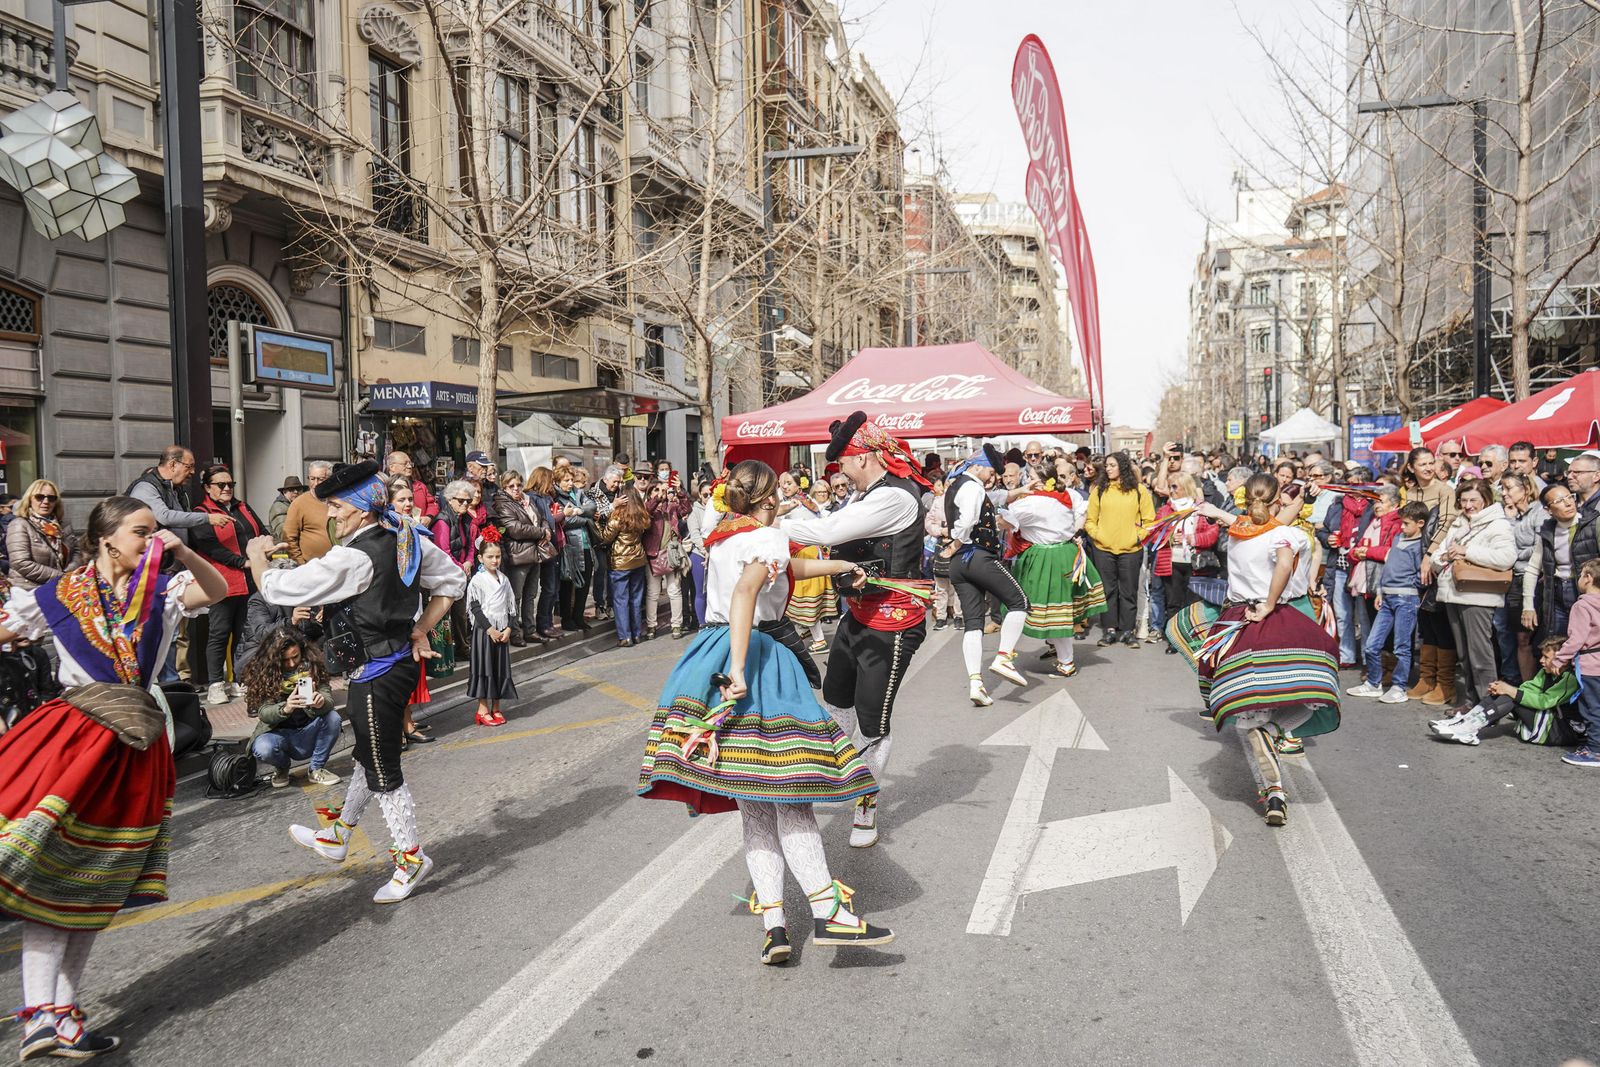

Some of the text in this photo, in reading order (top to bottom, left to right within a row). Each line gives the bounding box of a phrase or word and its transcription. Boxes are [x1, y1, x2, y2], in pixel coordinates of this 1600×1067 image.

[373, 385, 429, 399] MENARA
[435, 390, 450, 402] ARTE
[826, 374, 997, 405] Coca-Cola
[874, 411, 927, 431] Coca-Cola
[1018, 406, 1074, 426] Coca-Cola
[736, 418, 788, 438] Coca-Cola
